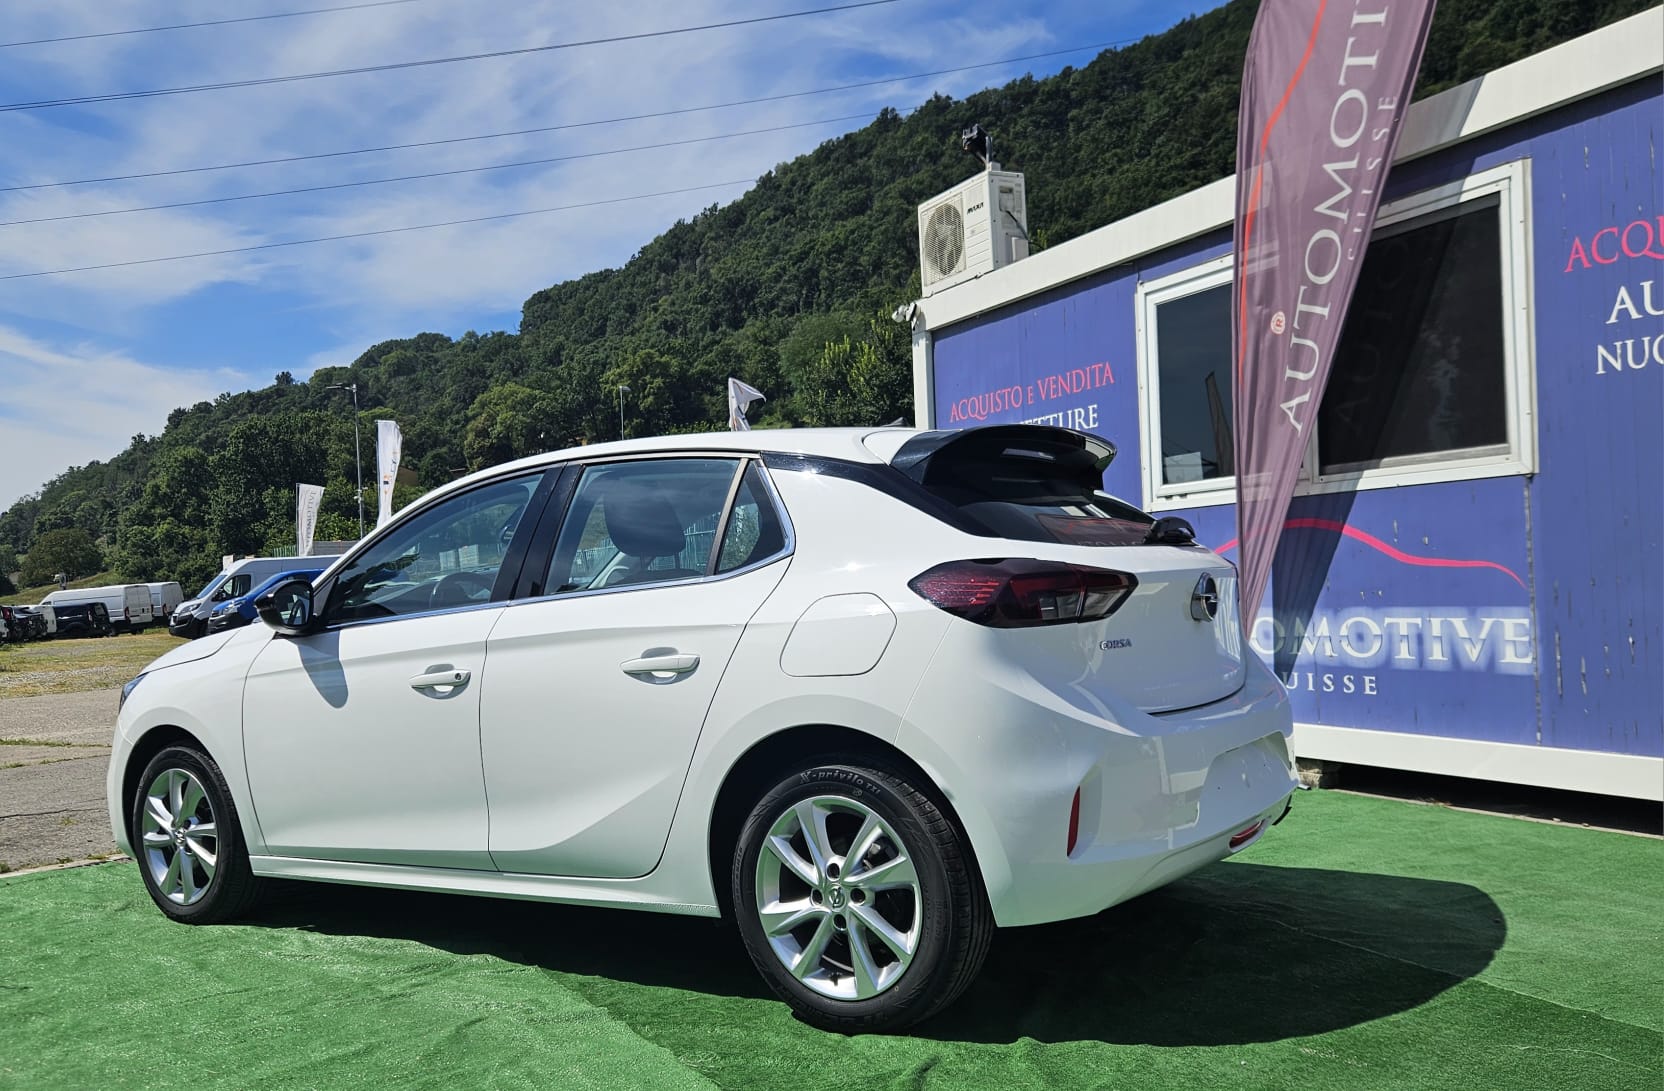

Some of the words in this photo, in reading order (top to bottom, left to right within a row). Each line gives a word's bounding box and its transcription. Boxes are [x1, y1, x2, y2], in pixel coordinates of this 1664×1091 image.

[1279, 0, 1389, 437] AUTOMOTI
[1563, 215, 1664, 273] ACQ
[949, 386, 1023, 422] ACQUISTO
[1027, 385, 1035, 405] E
[1037, 362, 1115, 401] VENDITA
[1099, 638, 1132, 651] CORSA
[1249, 616, 1533, 664] OMOTIVE
[1282, 671, 1377, 696] UISSE
